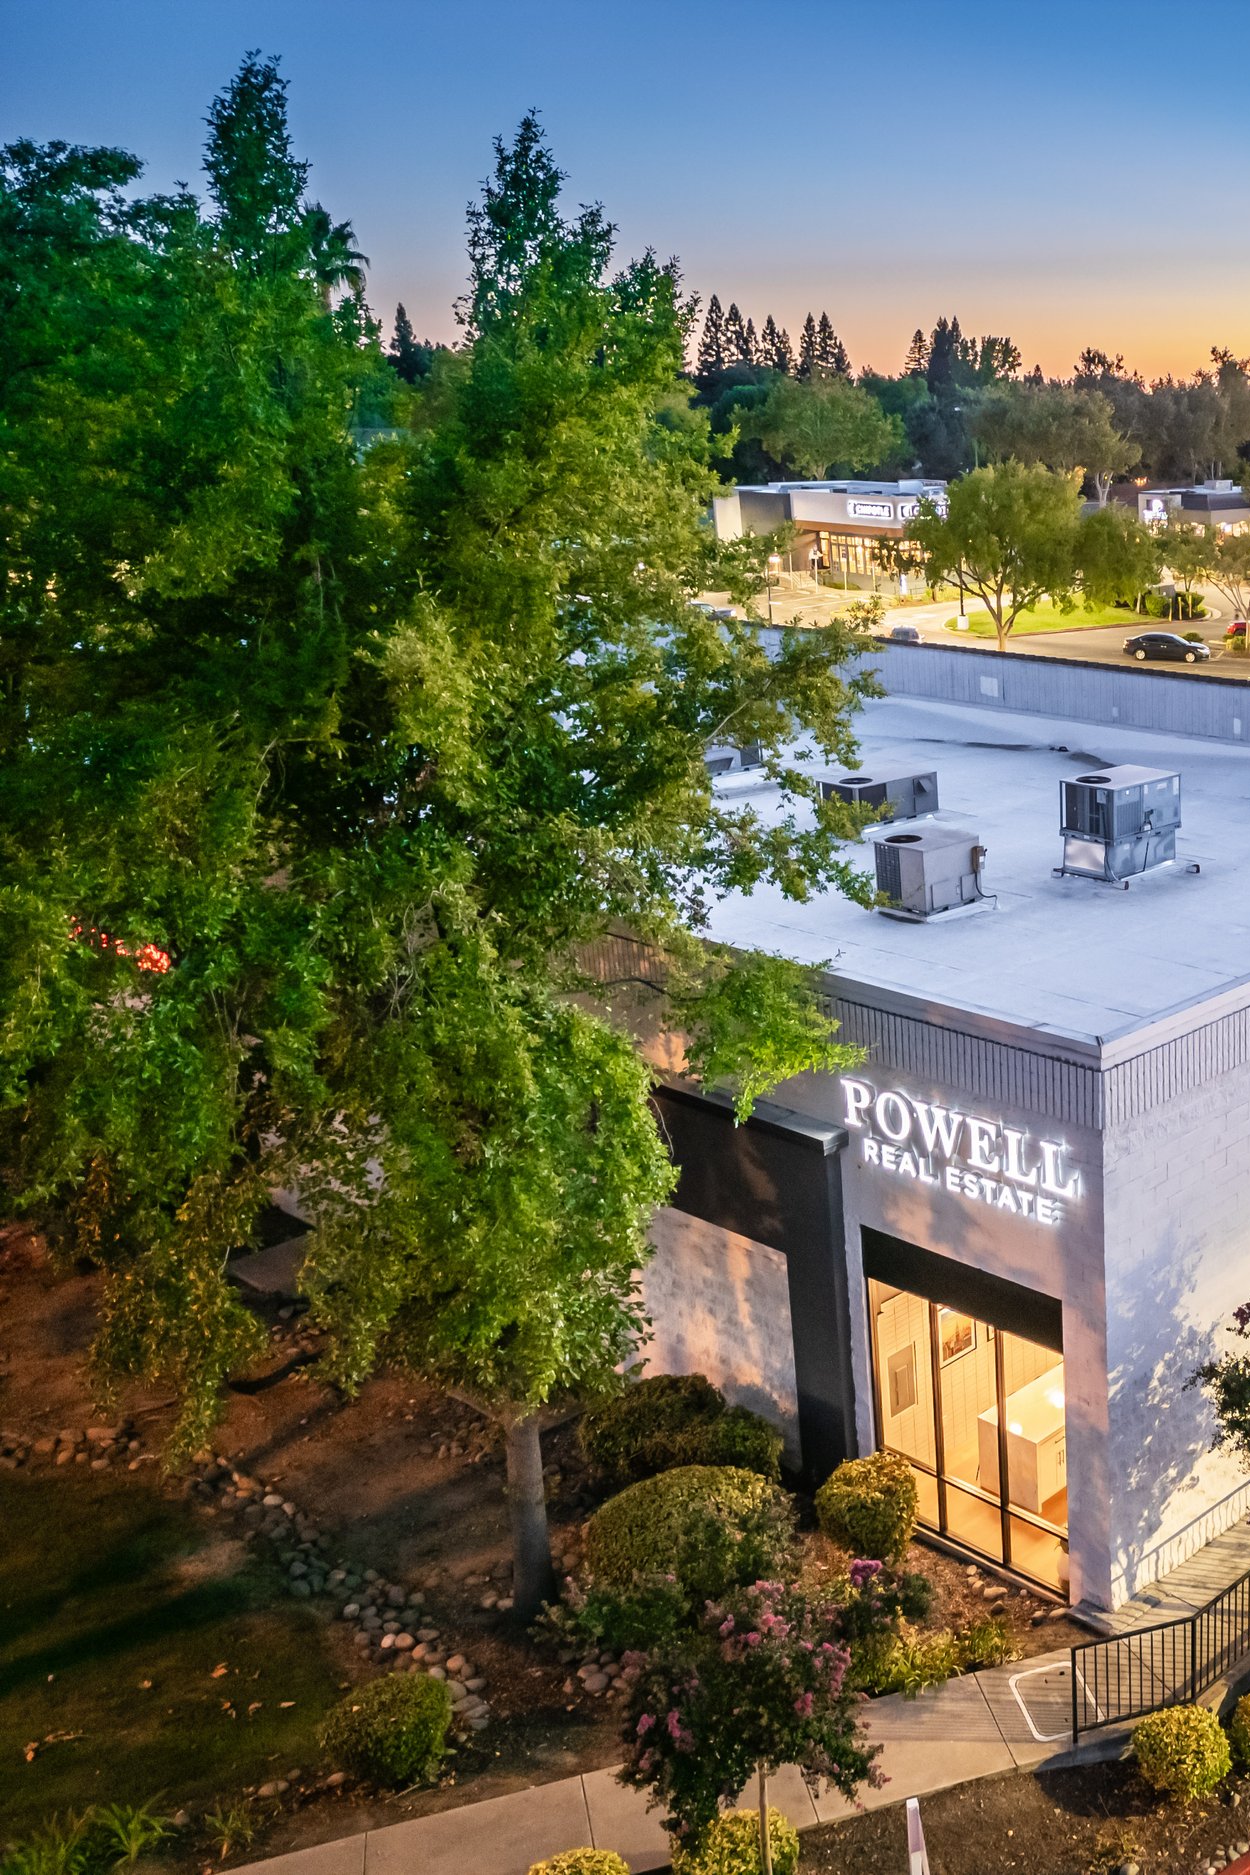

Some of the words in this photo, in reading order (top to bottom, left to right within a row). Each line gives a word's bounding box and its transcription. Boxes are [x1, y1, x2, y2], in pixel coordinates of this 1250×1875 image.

[840, 1078, 1076, 1198] POWELL
[863, 1137, 934, 1184] REAL
[946, 1165, 1054, 1224] ESTATE
